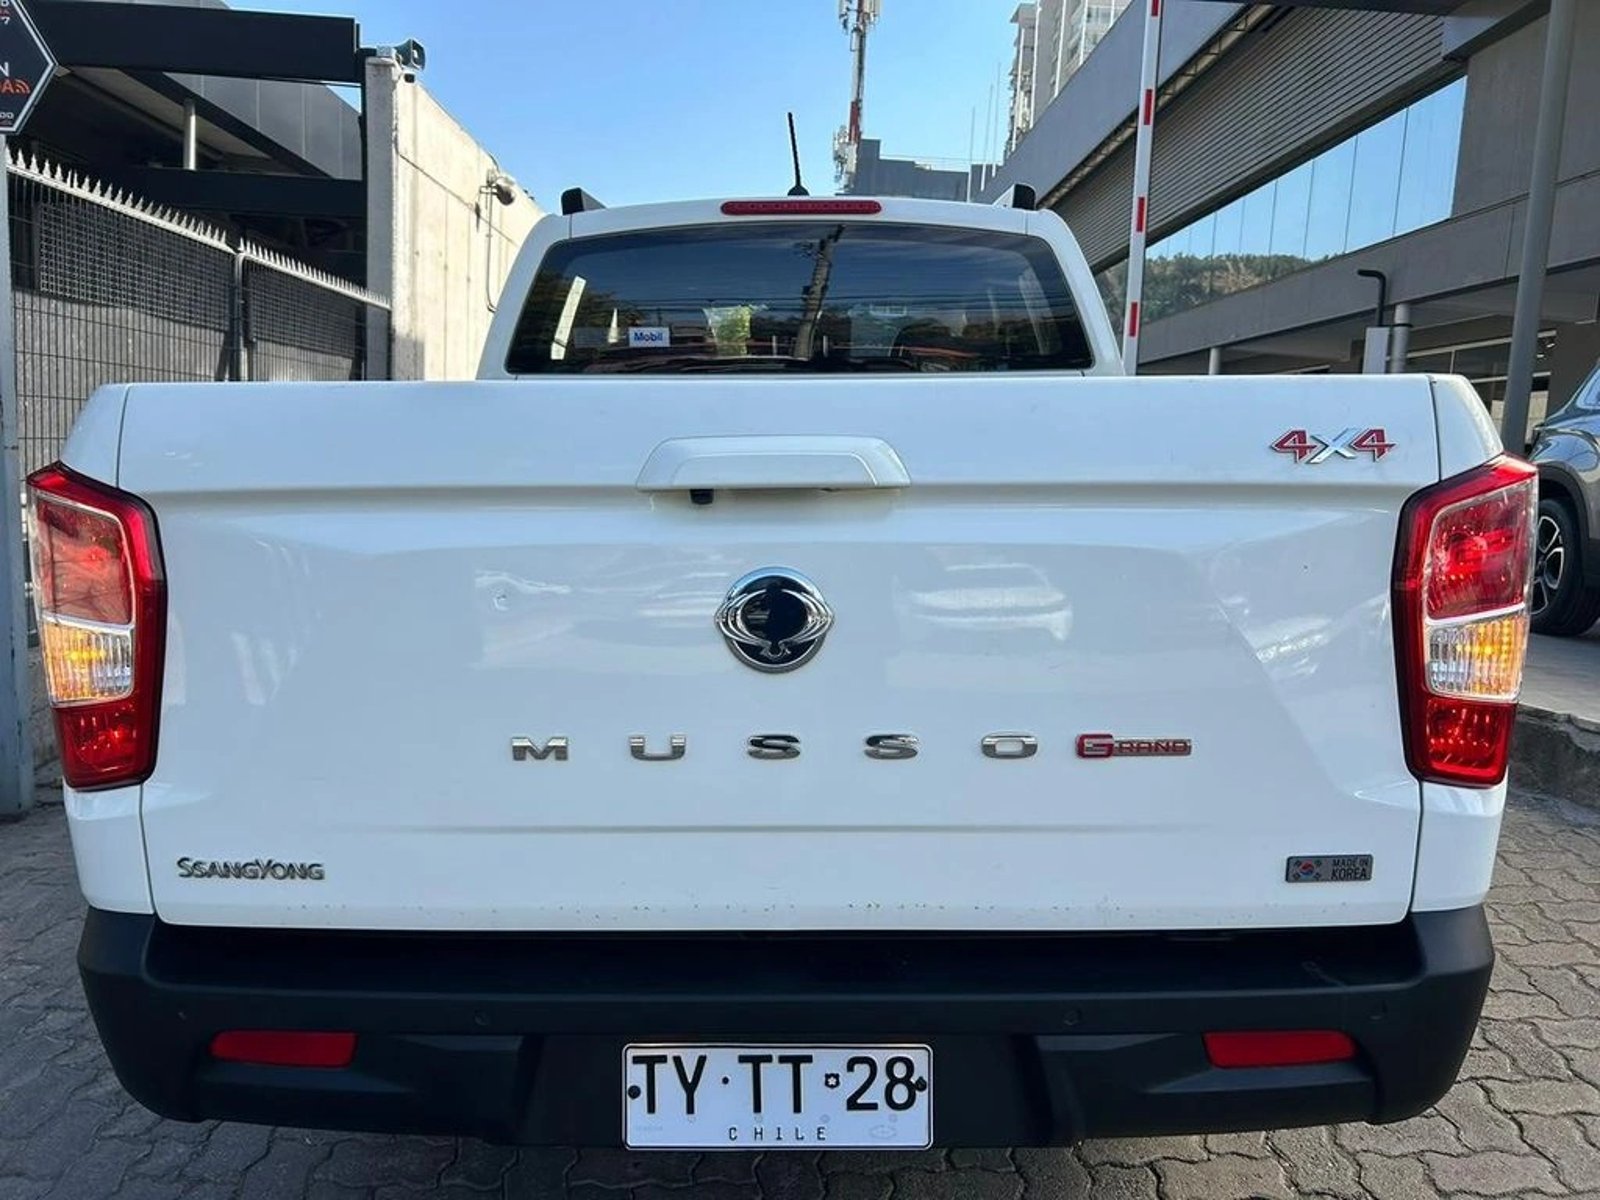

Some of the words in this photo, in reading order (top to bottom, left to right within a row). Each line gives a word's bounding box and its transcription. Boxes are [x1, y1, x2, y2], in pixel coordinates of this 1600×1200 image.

[634, 332, 663, 341] Mobil
[510, 734, 1039, 761] MUSSO
[1332, 859, 1358, 867] MADE
[1331, 868, 1367, 880] KOREA
[728, 1127, 827, 1140] CHILE
